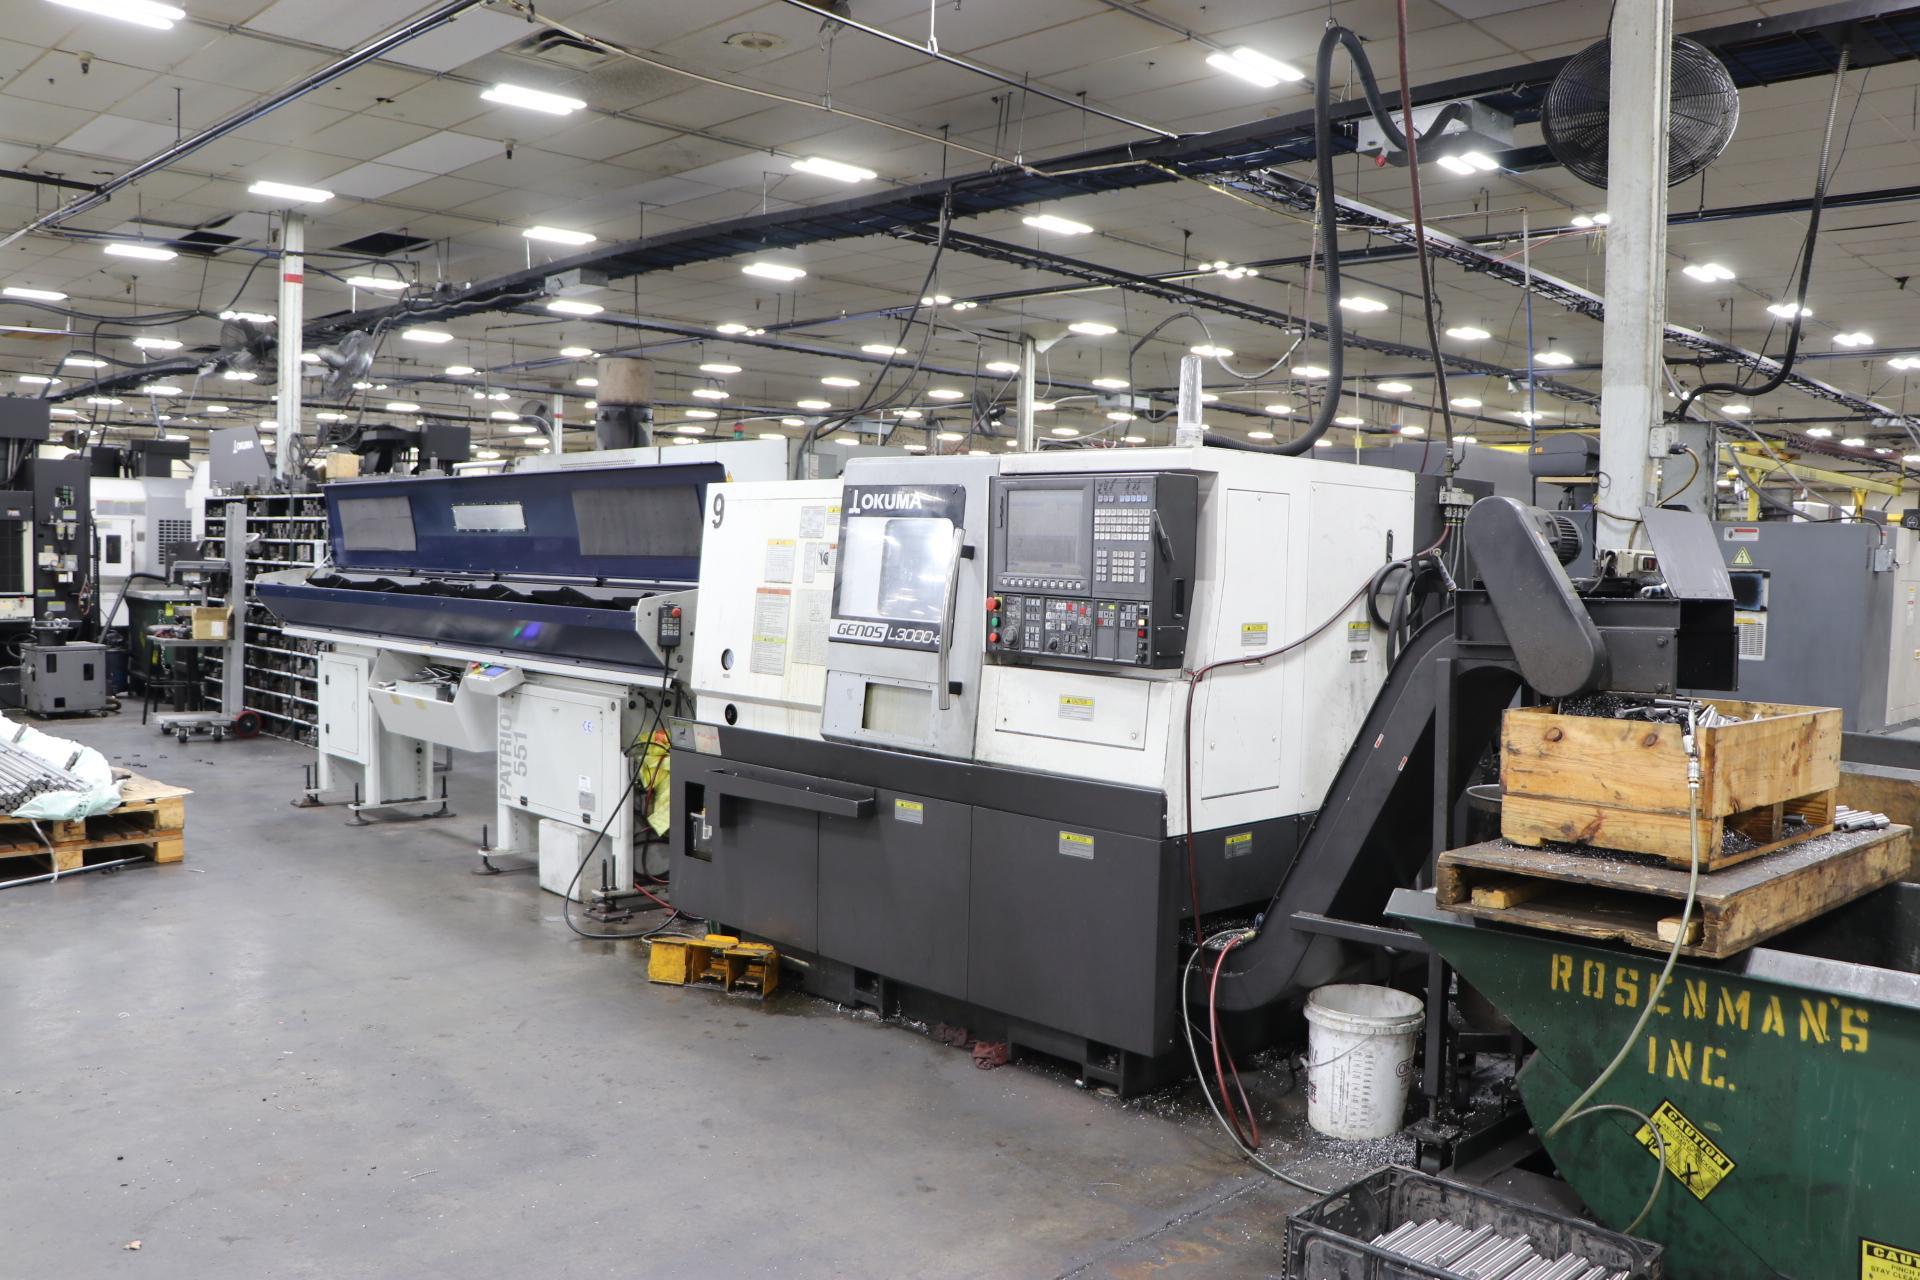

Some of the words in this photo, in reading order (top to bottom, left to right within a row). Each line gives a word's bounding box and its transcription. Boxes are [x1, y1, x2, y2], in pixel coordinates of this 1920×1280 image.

[712, 493, 725, 529] 9
[861, 492, 922, 510] OKUMA
[837, 622, 884, 639] GENOS
[513, 731, 528, 777] 551
[1550, 953, 1869, 1053] ROSENMAN'S
[1647, 1036, 1736, 1091] INC.
[1666, 1110, 1725, 1166] CAUTION
